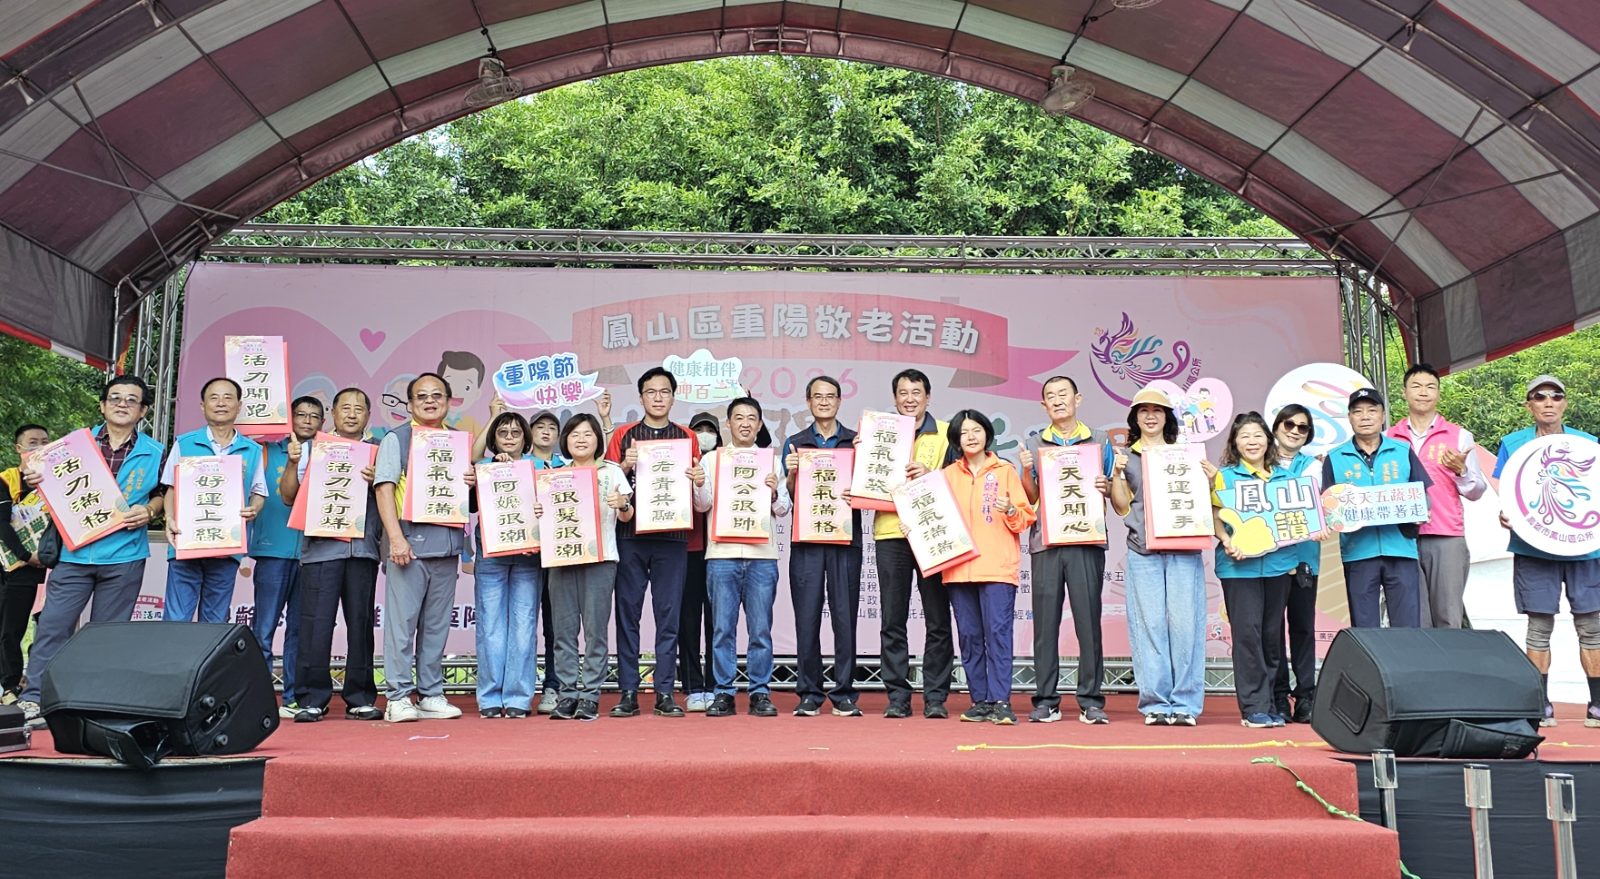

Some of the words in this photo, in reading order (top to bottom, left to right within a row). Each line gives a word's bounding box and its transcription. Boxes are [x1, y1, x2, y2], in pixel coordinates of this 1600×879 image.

[602, 303, 980, 354] 鳳山區重陽敬老活動
[242, 354, 271, 418] 活力開跑
[504, 356, 574, 387] 重陽節
[536, 381, 582, 405] 快樂
[669, 360, 737, 377] 健康相伴
[53, 457, 113, 528] 活力滿格
[195, 475, 225, 541] 好運上線
[321, 462, 353, 530] 活力不打烊
[427, 449, 454, 515] 福氣拉滿
[493, 480, 527, 543] 阿嬤很潮
[650, 461, 677, 522] 老青共融
[732, 466, 758, 531] 阿公很帥
[811, 468, 838, 534] 福氣滿格
[1059, 467, 1090, 533] 天天開心
[1164, 464, 1195, 529] 好運到手
[1235, 479, 1315, 513] 鳳山
[1344, 503, 1426, 521] 健康帶著走
[551, 491, 583, 558] 銀髮很潮
[912, 492, 954, 557] 福氣滿滿
[1274, 511, 1311, 541] 讚
